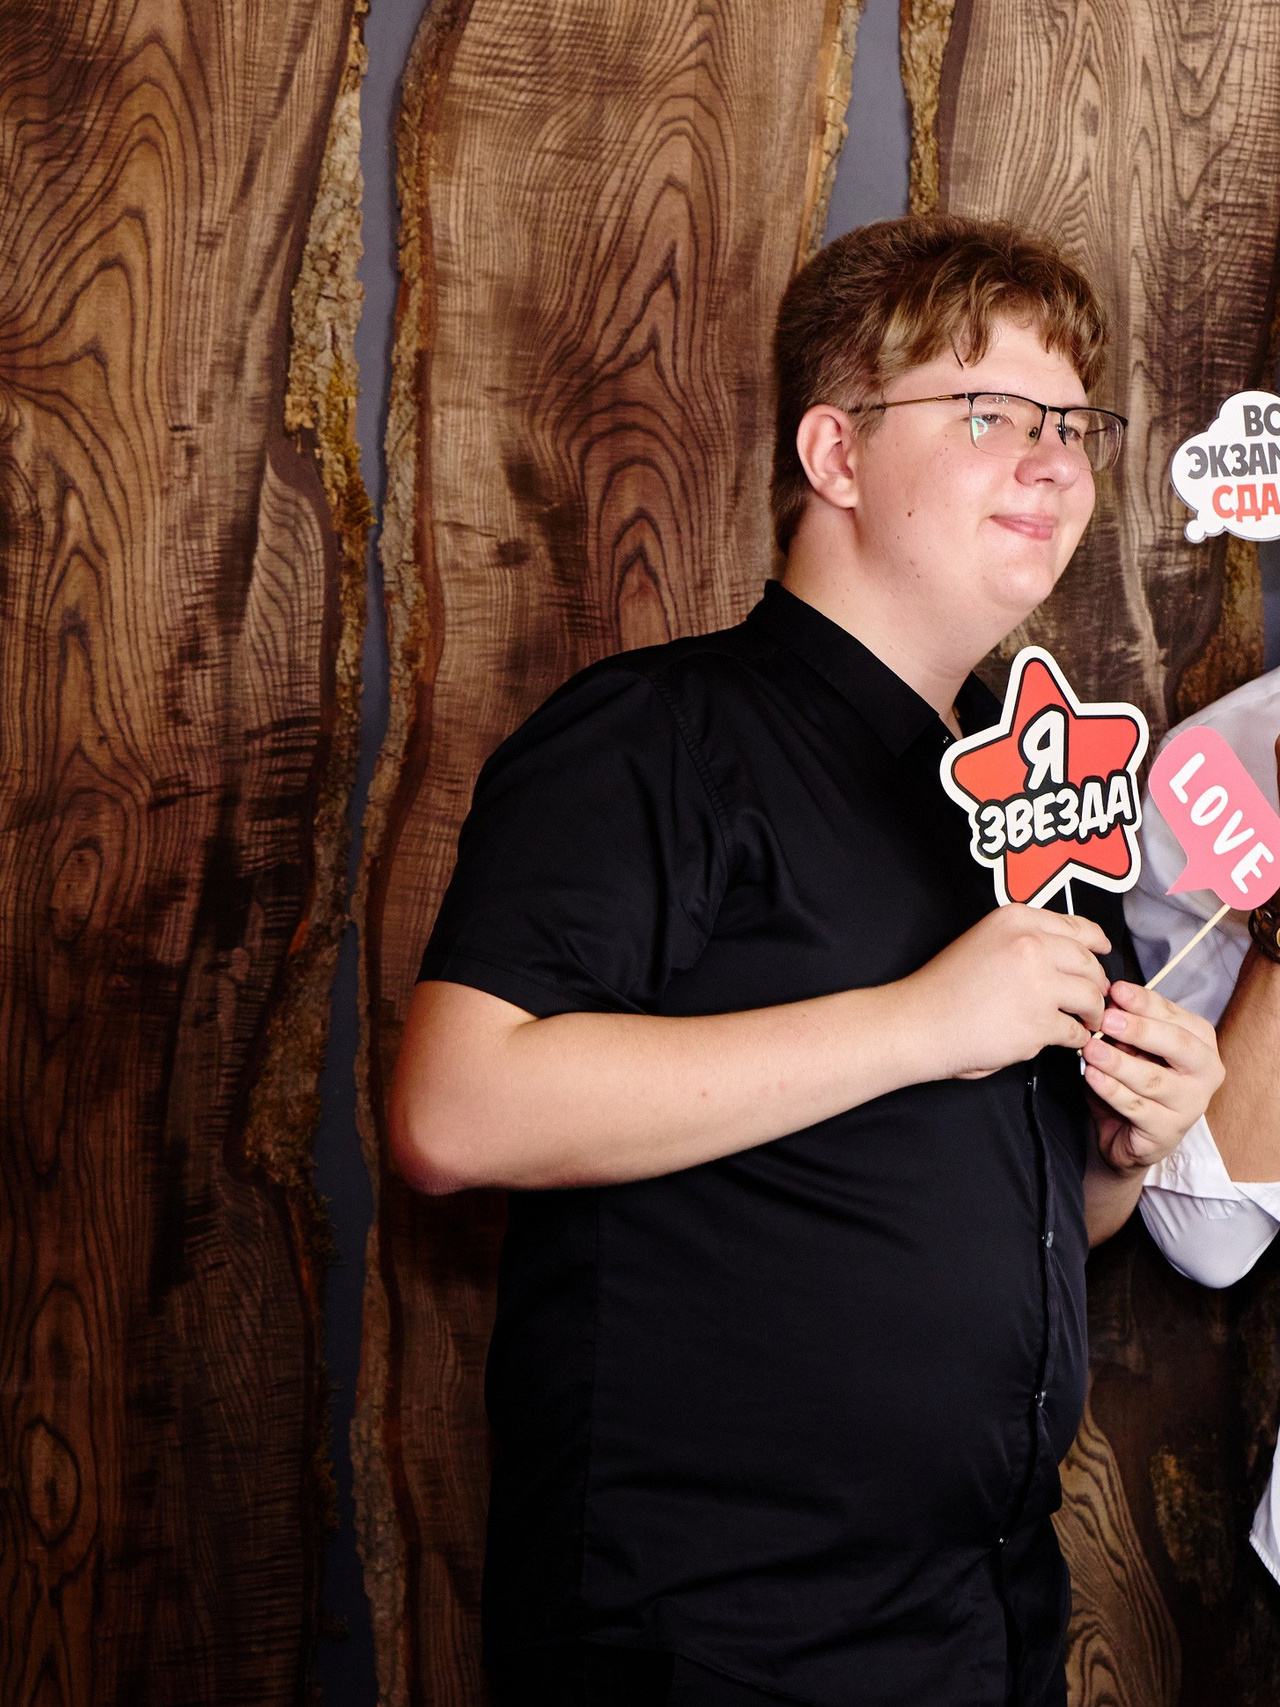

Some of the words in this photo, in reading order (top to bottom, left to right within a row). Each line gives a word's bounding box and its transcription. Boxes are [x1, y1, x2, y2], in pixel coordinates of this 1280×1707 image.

[1023, 709, 1066, 789] Я
[979, 774, 1132, 854] ЗВЕЗДА
[1169, 752, 1275, 894] LOVE
